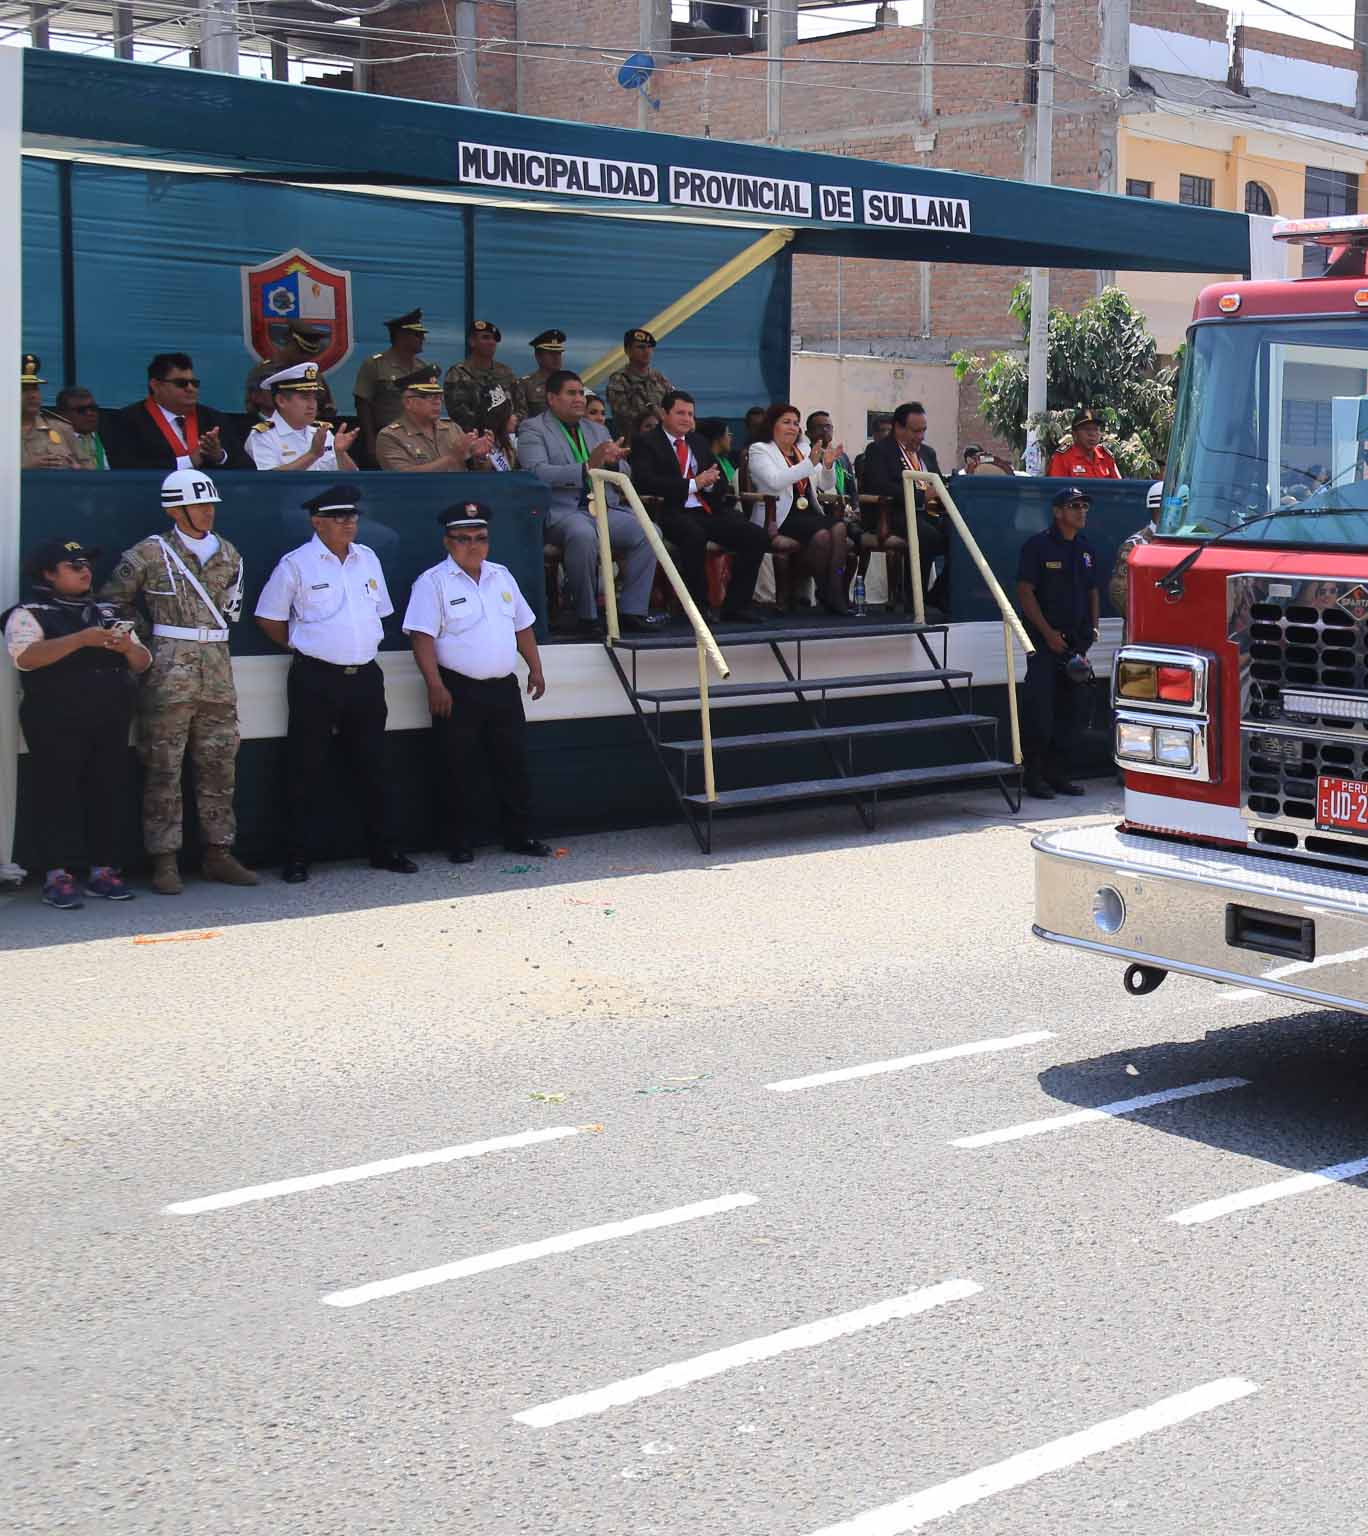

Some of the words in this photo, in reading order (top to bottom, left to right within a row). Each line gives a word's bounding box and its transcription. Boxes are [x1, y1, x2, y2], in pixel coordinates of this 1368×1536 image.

[462, 145, 656, 197] MUNICIPALIDAD
[674, 171, 809, 214] PROVINCIAL
[823, 189, 852, 218] DE
[868, 194, 967, 229] SULLANA
[1342, 781, 1368, 794] PERU
